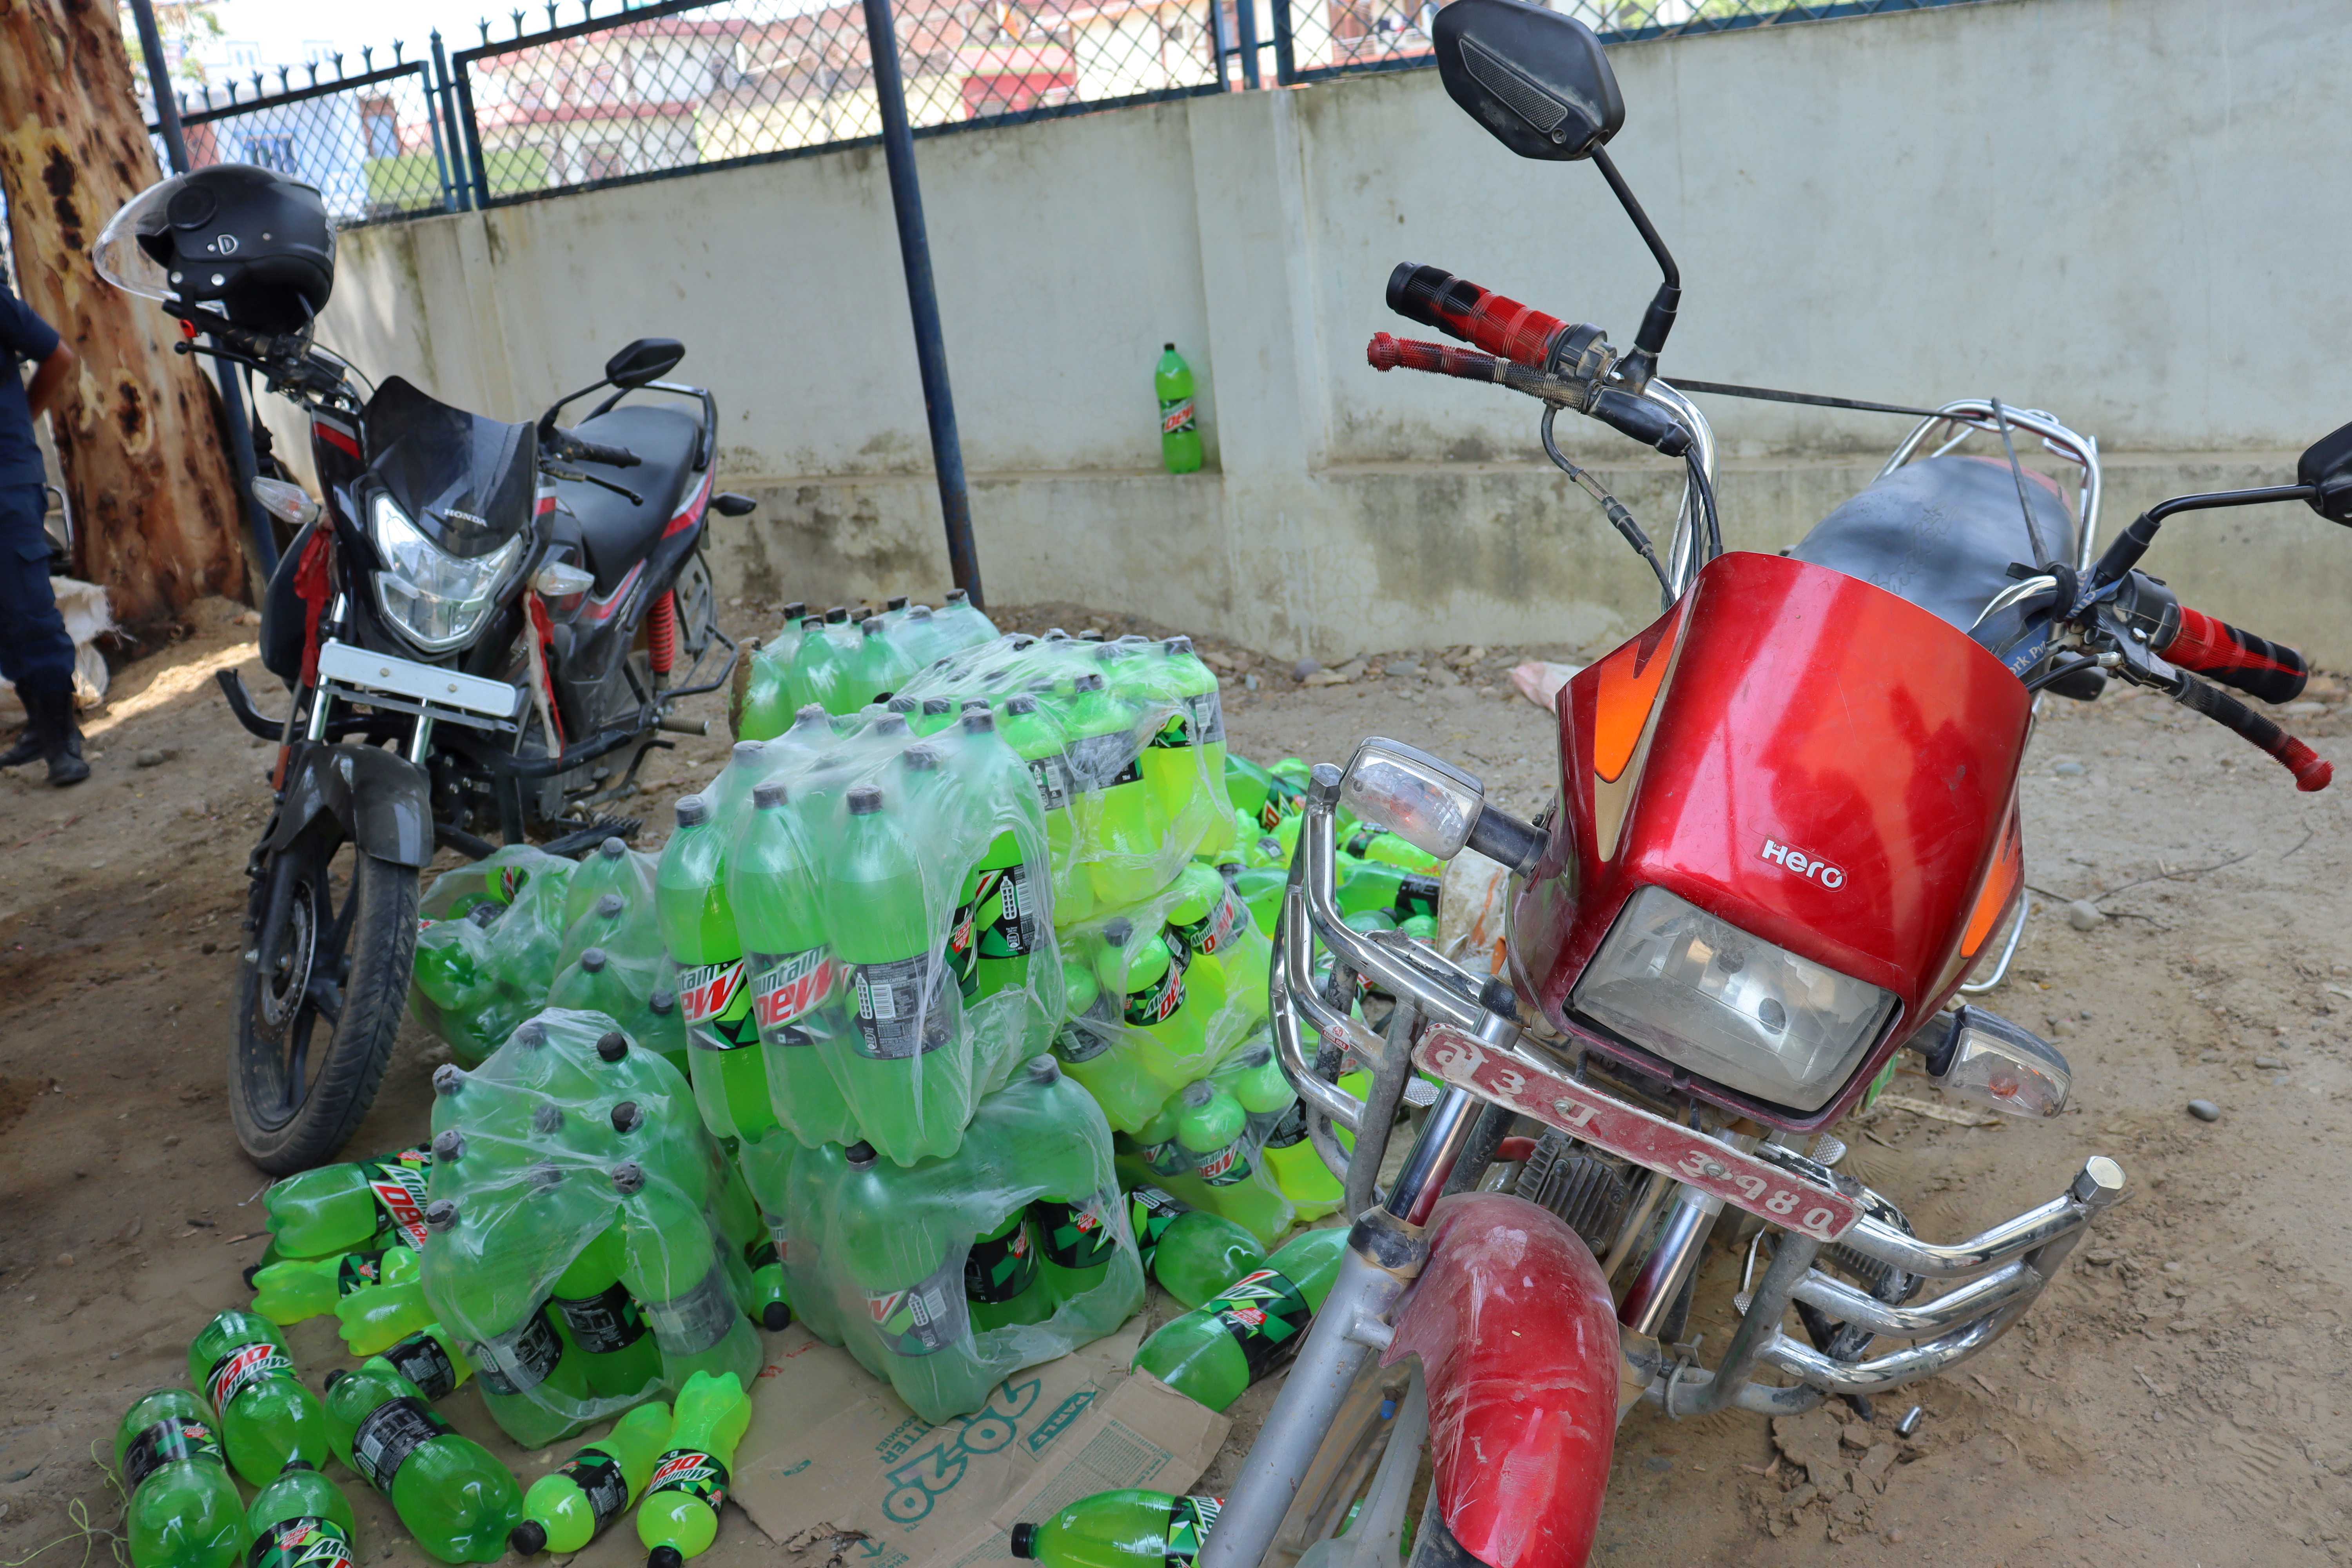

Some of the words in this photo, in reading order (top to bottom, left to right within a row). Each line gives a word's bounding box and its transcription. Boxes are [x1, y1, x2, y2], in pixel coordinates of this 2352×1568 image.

[444, 508, 487, 527] HONDA
[1762, 839, 1843, 888] Hero
[681, 962, 744, 1021] ew
[1336, 1039, 1346, 1049] GOLD
[375, 1185, 425, 1227] De
[1033, 1394, 1092, 1445] PARLE
[879, 1420, 936, 1465] TTER
